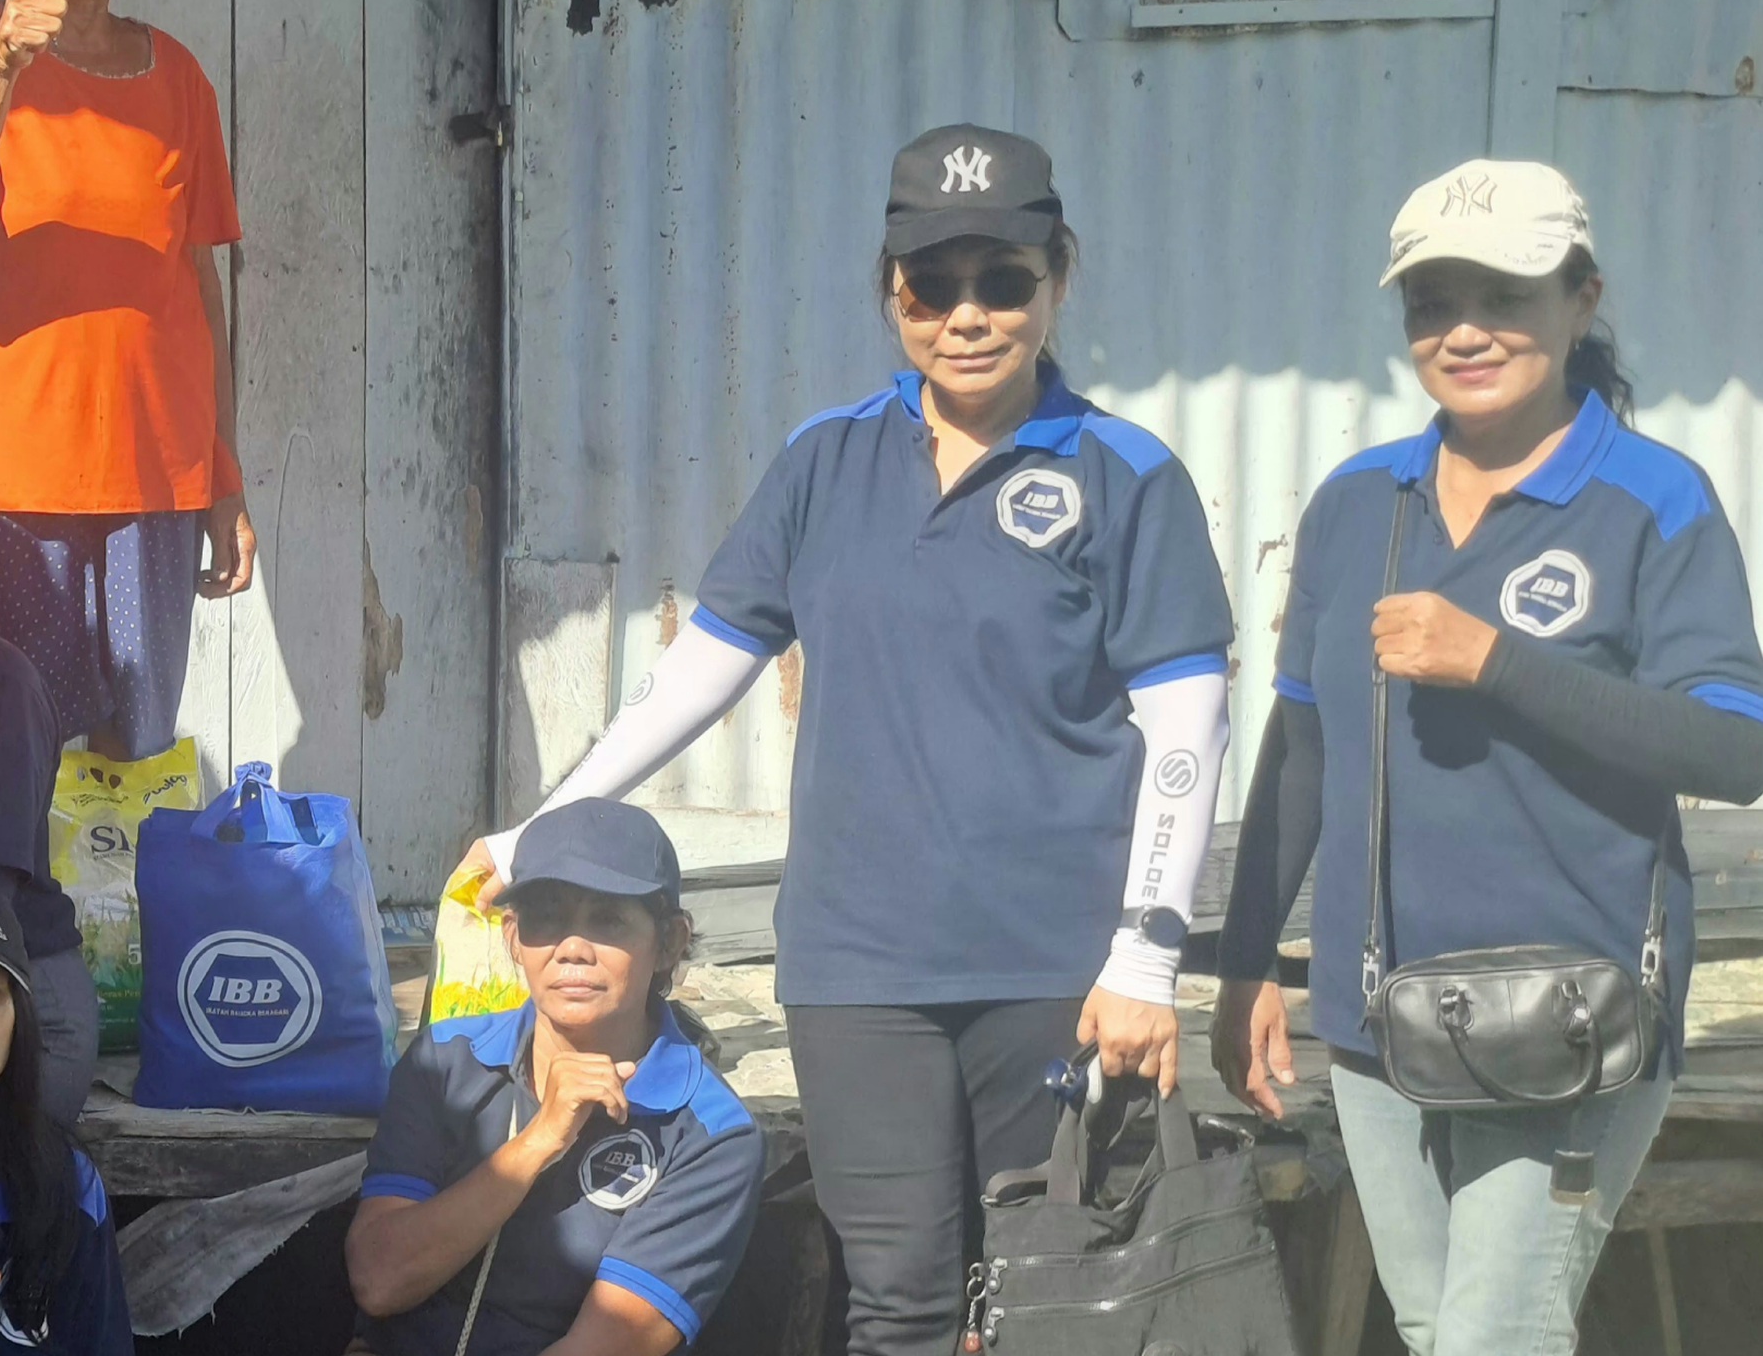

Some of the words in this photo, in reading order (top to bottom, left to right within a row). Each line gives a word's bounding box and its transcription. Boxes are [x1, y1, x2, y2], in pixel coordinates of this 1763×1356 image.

[940, 145, 992, 193] NY
[1440, 174, 1498, 217] NY
[1133, 812, 1176, 945] SOLDE
[208, 976, 283, 1004] IBB
[605, 1151, 636, 1167] IBB
